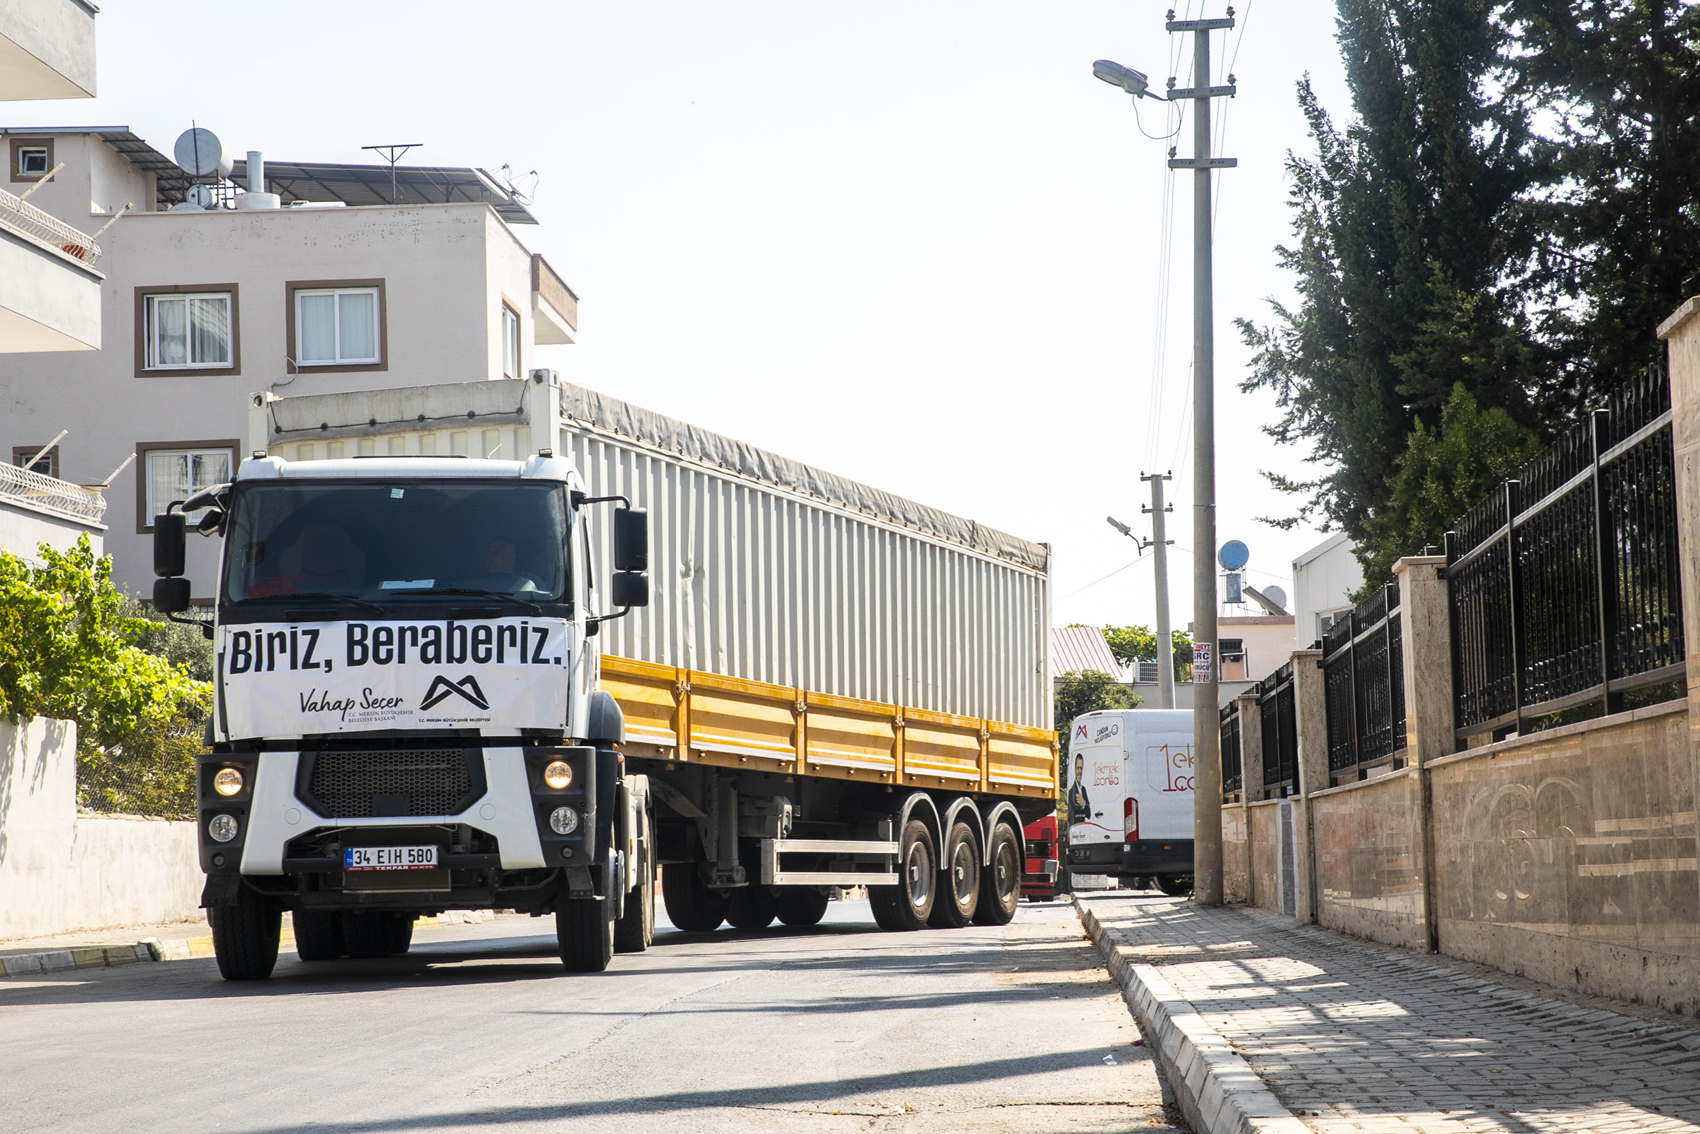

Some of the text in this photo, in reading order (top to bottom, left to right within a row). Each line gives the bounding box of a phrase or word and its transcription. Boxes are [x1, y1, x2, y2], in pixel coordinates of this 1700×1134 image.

[230, 620, 562, 674] Biriz, Beraberiz.
[300, 687, 404, 722] Vahap Seçer
[354, 848, 433, 865] 34 EIH 580
